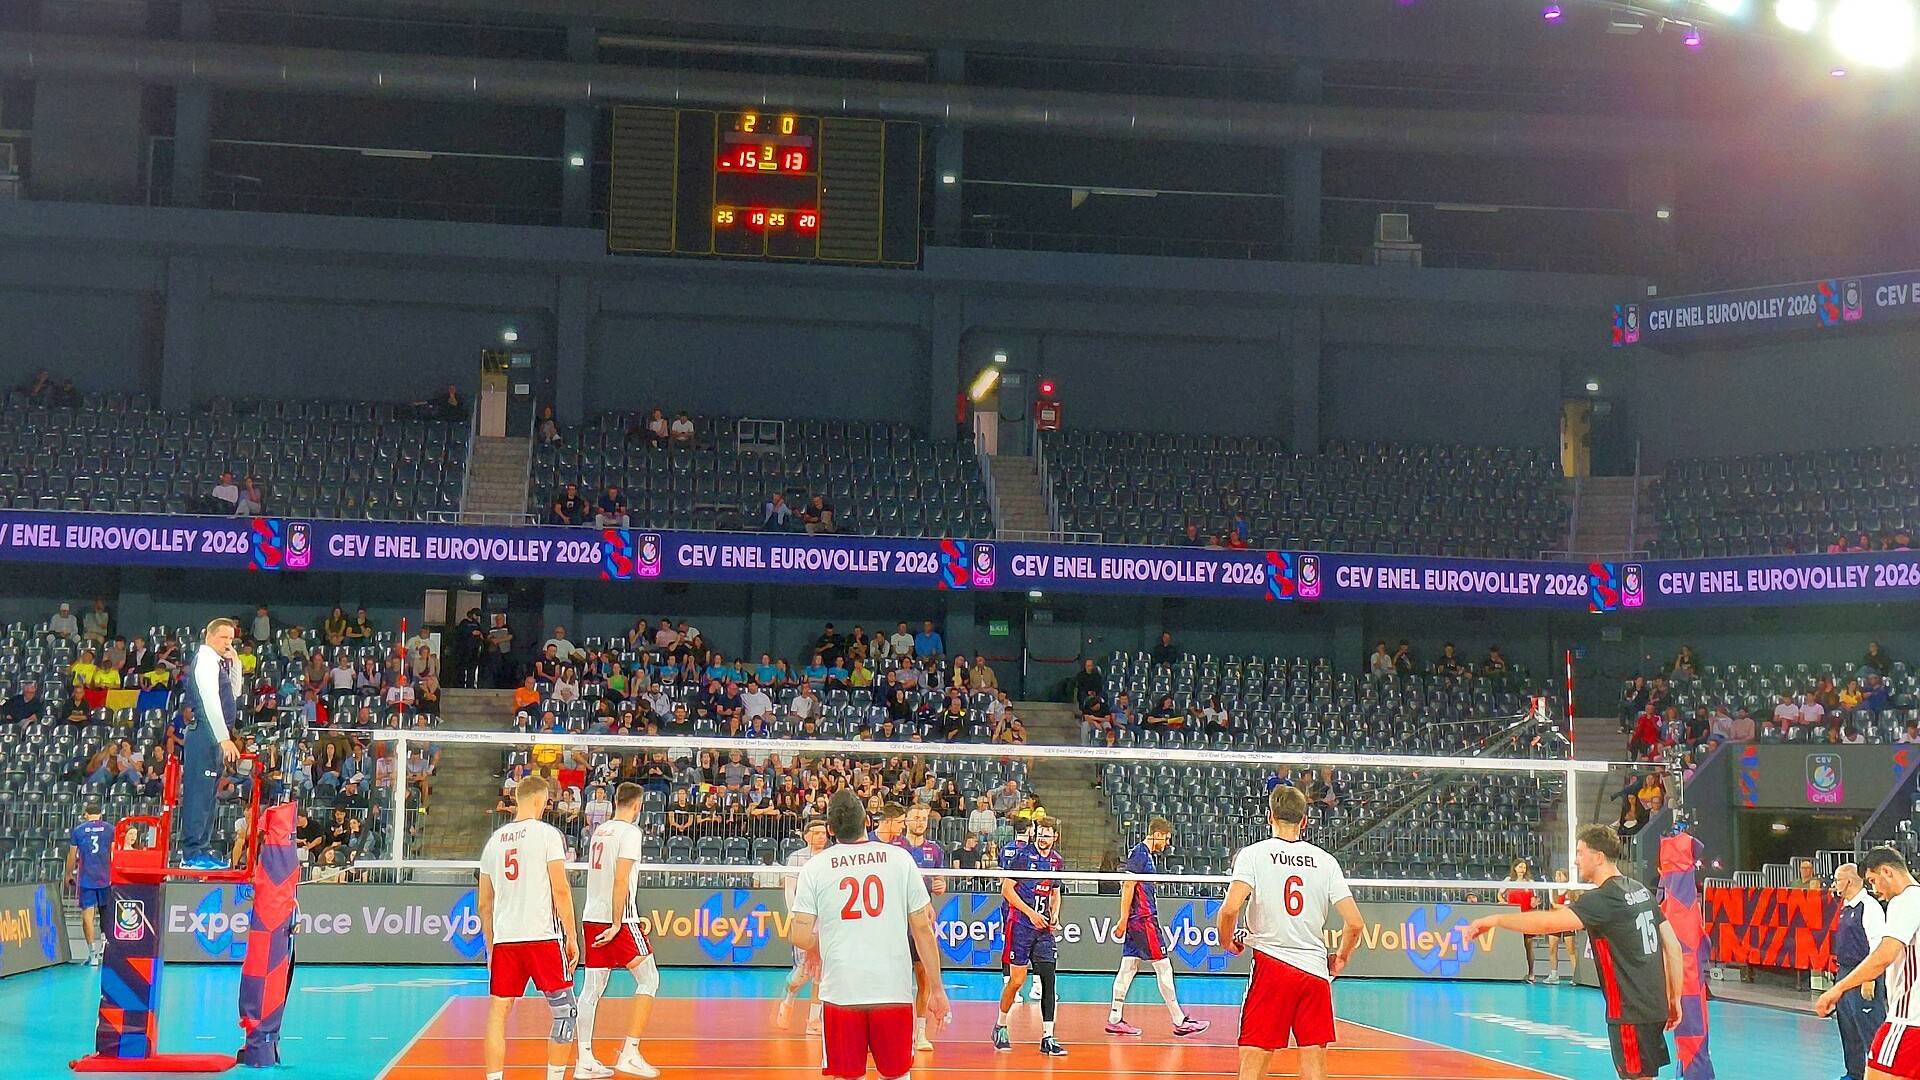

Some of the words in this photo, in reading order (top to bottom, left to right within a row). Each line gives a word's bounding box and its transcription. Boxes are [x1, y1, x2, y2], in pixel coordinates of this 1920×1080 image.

[743, 115, 756, 132] 2
[782, 117, 794, 134] 0
[739, 152, 756, 168] 15
[785, 152, 803, 170] 13
[763, 146, 773, 161] 3
[717, 211, 734, 223] 25
[752, 213, 764, 225] 19
[769, 214, 785, 226] 25
[799, 215, 816, 227] 20
[1875, 284, 1908, 307] CEV
[1649, 311, 1674, 331] CEV
[1675, 306, 1704, 328] ENEL
[1706, 297, 1785, 324] EUROVOLLEY
[1786, 294, 1817, 315] 2026
[12, 524, 60, 548] ENEL
[66, 526, 197, 552] EUROVOLLEY
[201, 530, 249, 554] 2026
[328, 534, 370, 557] CEV
[374, 536, 421, 558] ENEL
[426, 537, 552, 562] EUROVOLLEY
[556, 541, 602, 563] 2026
[678, 544, 718, 567] CEV
[721, 546, 763, 569] ENEL
[770, 547, 892, 572] EUROVOLLEY
[895, 551, 939, 574] 2026
[1011, 555, 1049, 577] CEV
[1053, 555, 1097, 579] ENEL
[1101, 558, 1218, 582] EUROVOLLEY
[1221, 562, 1265, 585] 2026
[1336, 566, 1374, 588] CEV
[1377, 567, 1420, 590] ENEL
[1424, 569, 1541, 594] EUROVOLLEY
[1544, 574, 1588, 596] 2026
[1659, 572, 1696, 595] CEV
[1700, 570, 1743, 593] ENEL
[1747, 565, 1870, 591] EUROVOLLEY
[1874, 563, 1920, 586] 2026
[1813, 792, 1837, 803] enel
[90, 835, 99, 854] 3
[592, 841, 603, 869] 12
[1270, 850, 1317, 868] YÜKSEL
[505, 848, 519, 880] 5
[831, 851, 887, 869] BAYRAM
[839, 874, 885, 920] 20
[1034, 895, 1047, 914] 15
[1284, 875, 1304, 917] 6
[168, 905, 351, 939] Expence
[1635, 910, 1658, 955] 15
